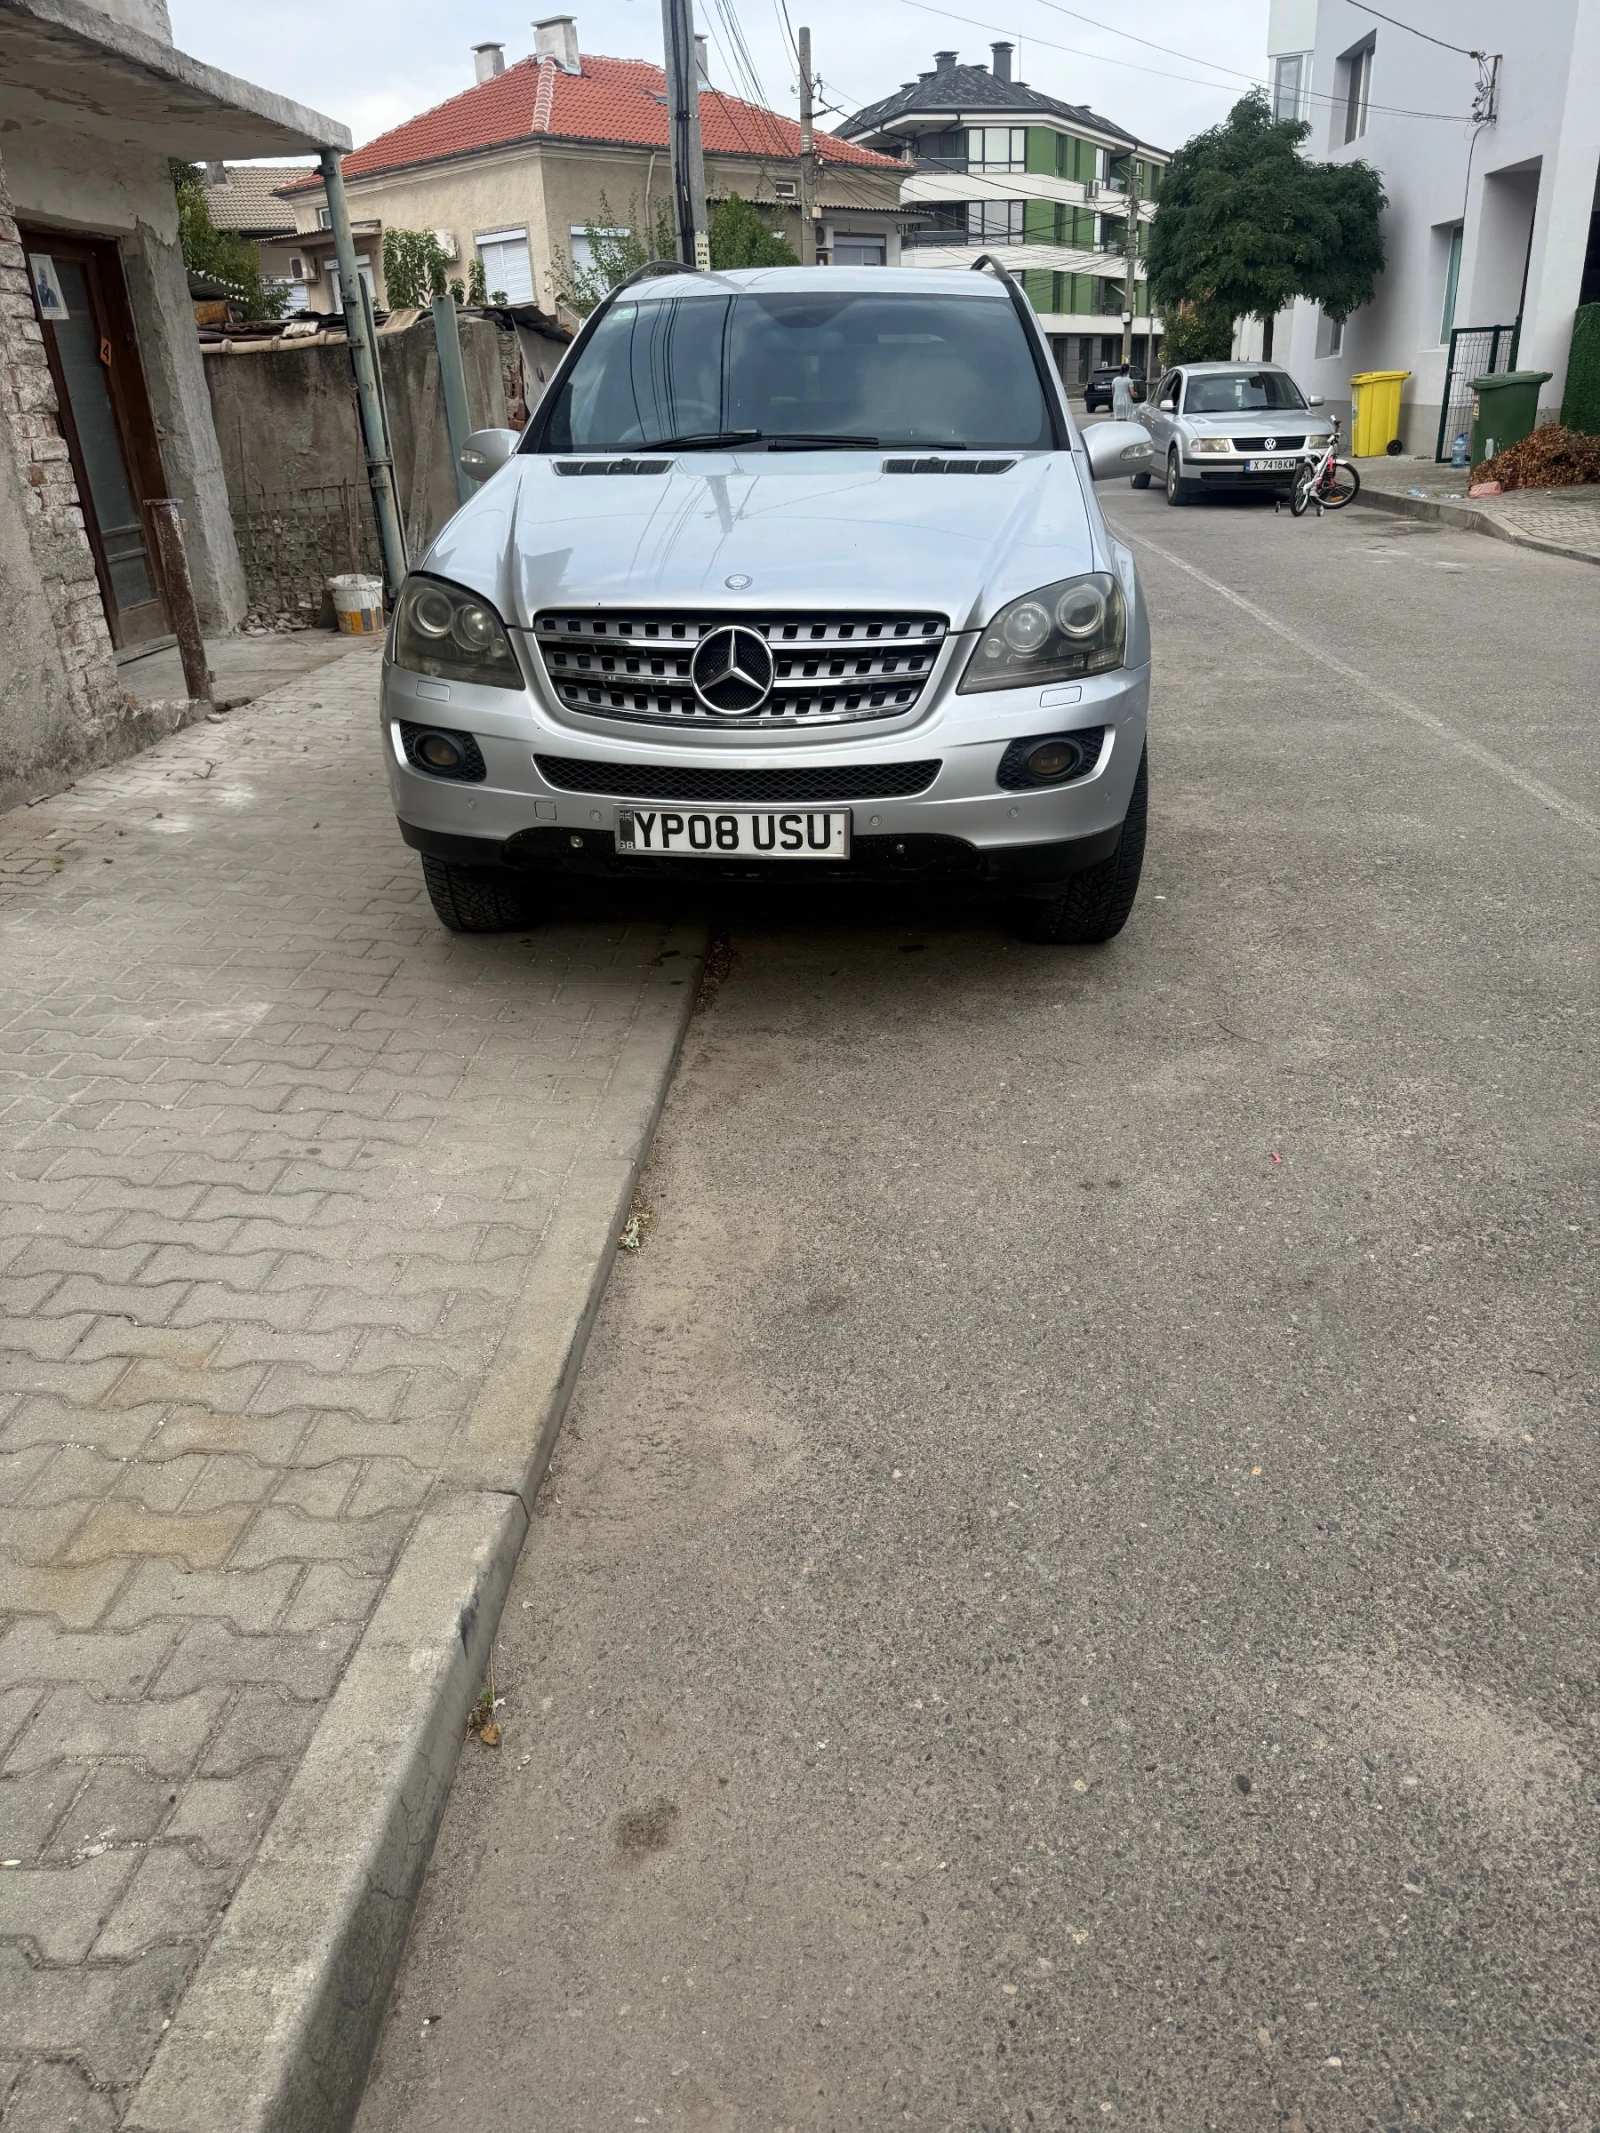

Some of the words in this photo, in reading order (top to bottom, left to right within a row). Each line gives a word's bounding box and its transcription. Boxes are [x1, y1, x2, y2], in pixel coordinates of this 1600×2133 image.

[103, 343, 108, 361] 4
[634, 812, 740, 850] YP08
[752, 814, 831, 850] USU
[620, 840, 634, 849] GB
